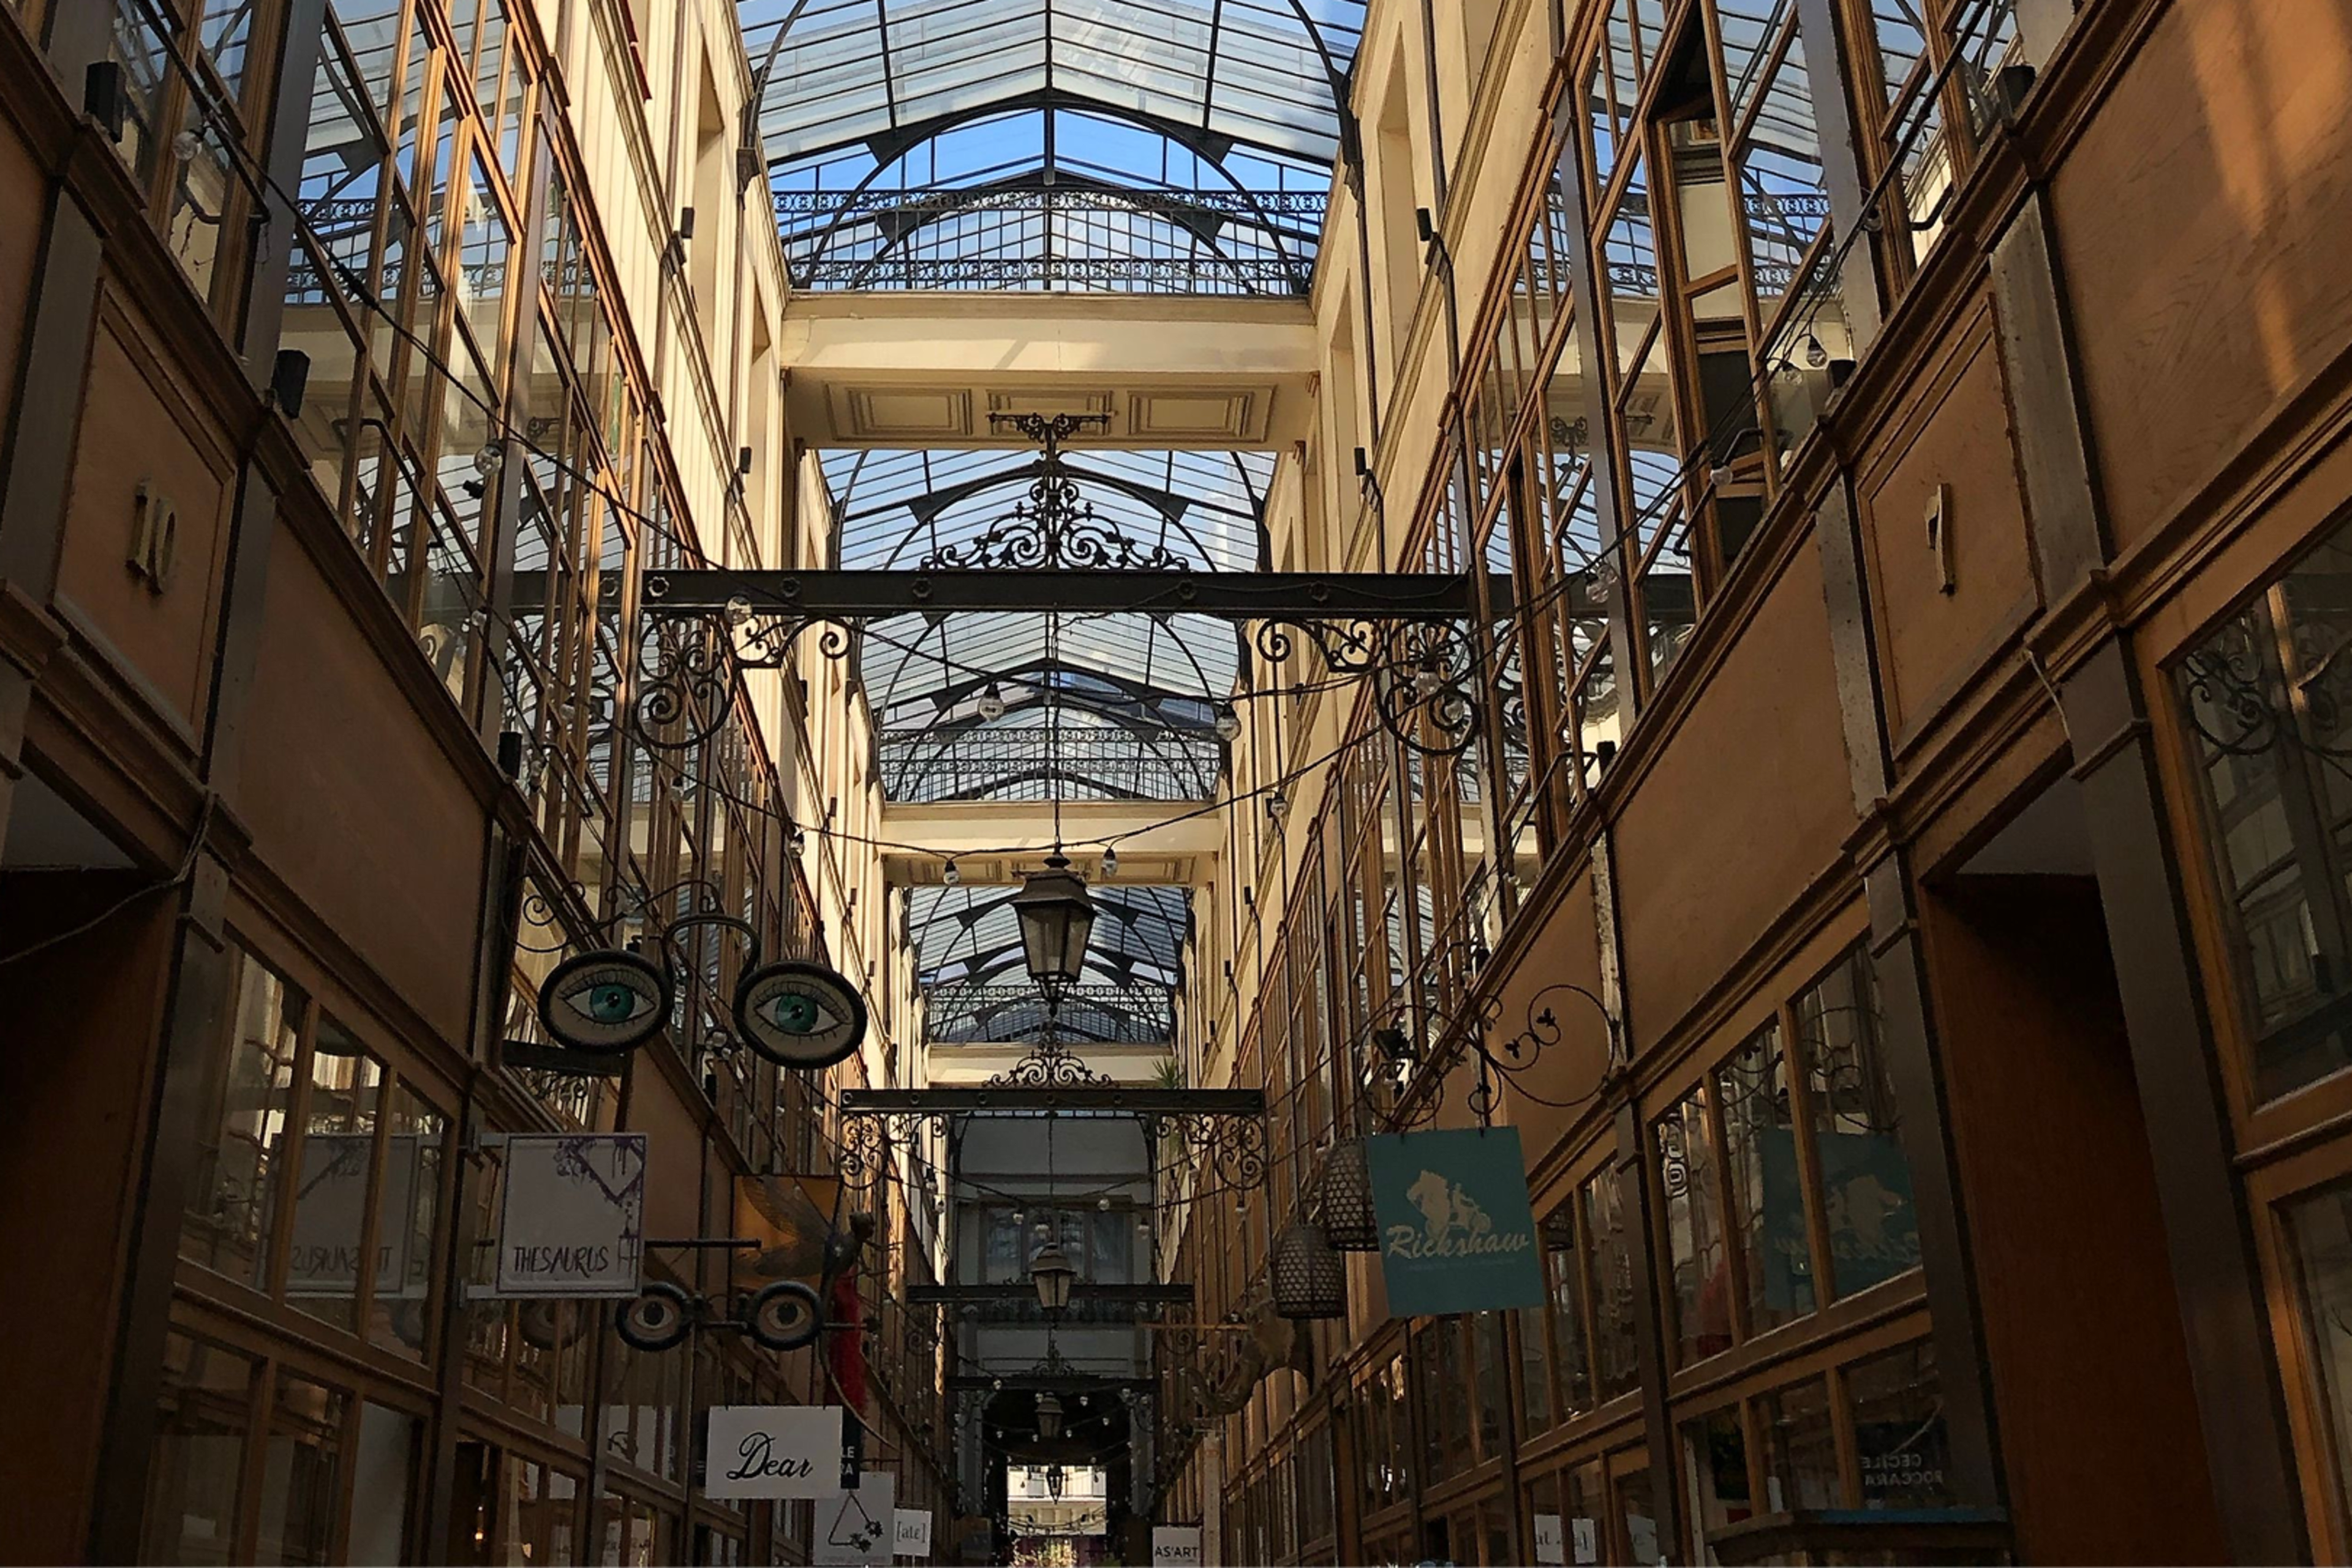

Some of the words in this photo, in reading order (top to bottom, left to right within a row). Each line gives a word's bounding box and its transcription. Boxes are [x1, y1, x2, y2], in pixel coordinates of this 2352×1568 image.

[1386, 1225, 1529, 1259] Rickshaw
[514, 1246, 609, 1278] THESAURUS
[726, 1432, 813, 1480] Dear
[1155, 1546, 1199, 1558] AS'ART
